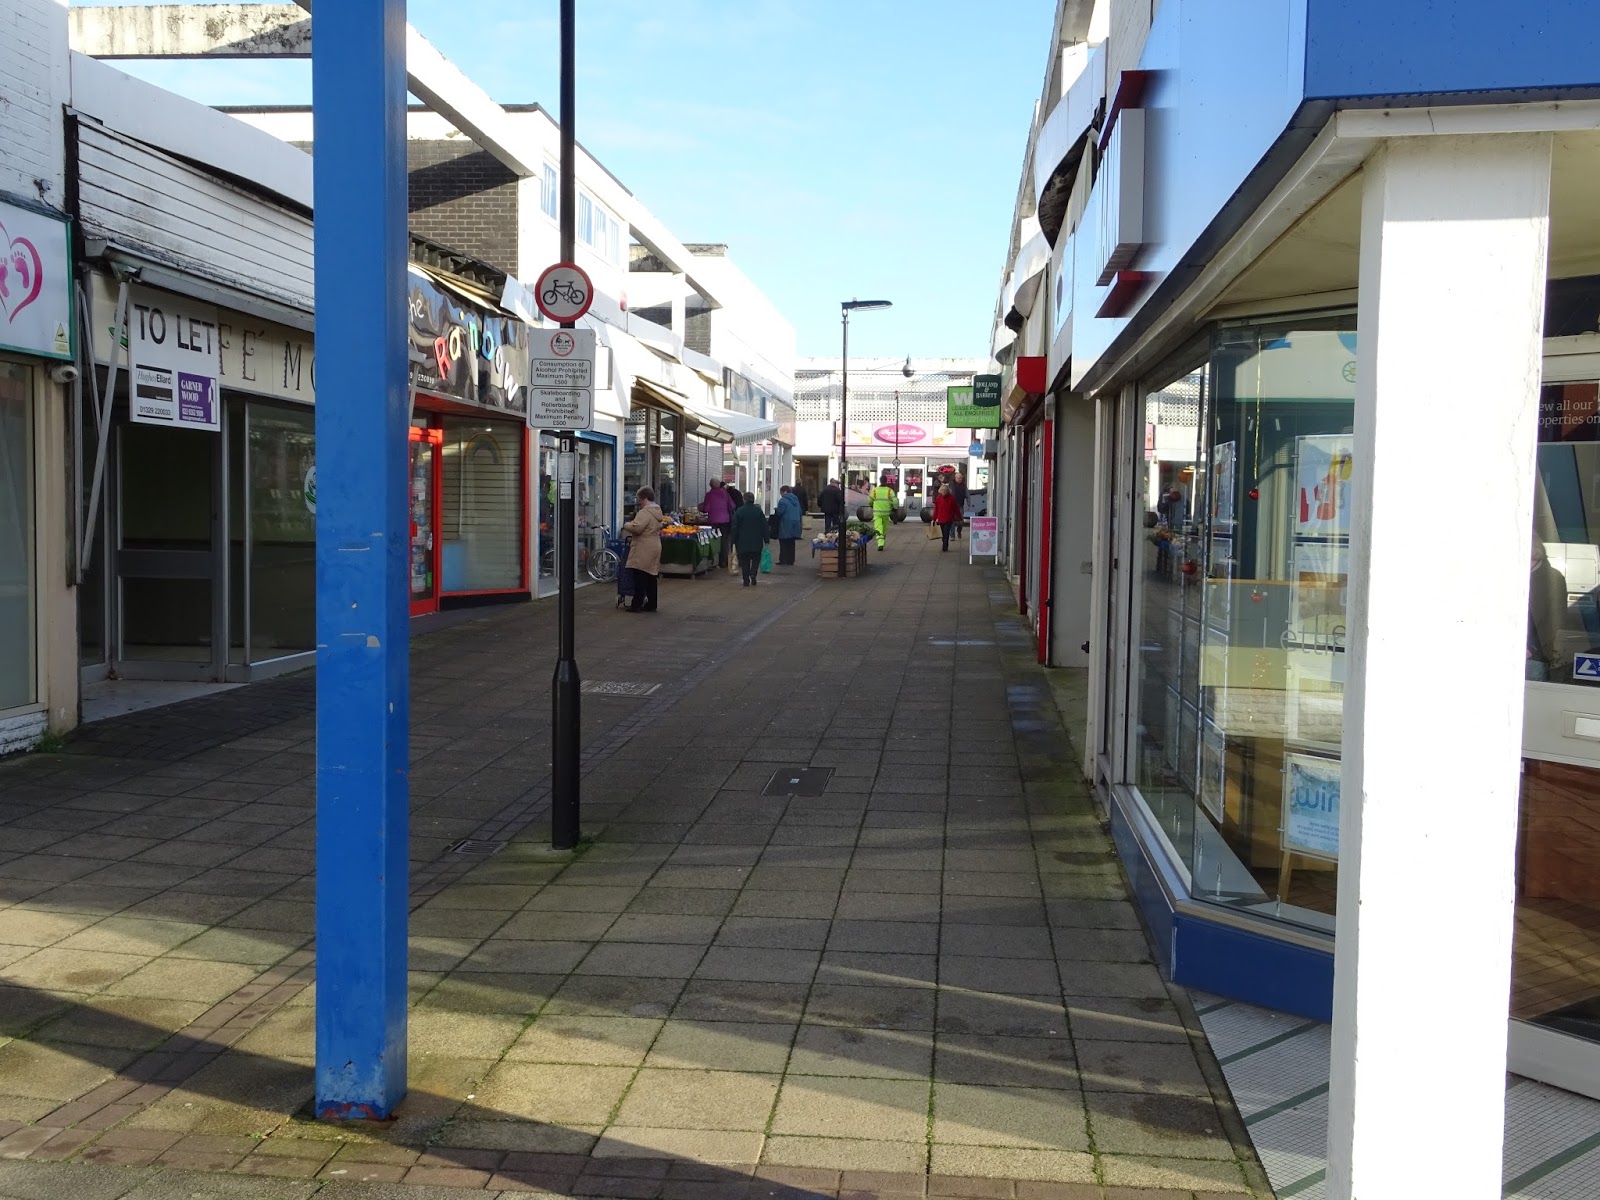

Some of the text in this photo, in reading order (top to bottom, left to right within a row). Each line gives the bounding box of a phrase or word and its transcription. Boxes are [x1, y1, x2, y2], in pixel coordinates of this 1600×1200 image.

[408, 296, 424, 321] he
[134, 304, 214, 354] TO LET
[218, 322, 315, 392] FÉ M
[435, 311, 519, 402] Ranbow
[181, 379, 203, 392] GARNER
[181, 390, 199, 402] WOOD
[139, 405, 154, 414] 01329
[1540, 400, 1593, 411] ew all our
[1539, 414, 1584, 428] operties
[562, 440, 567, 450] 1
